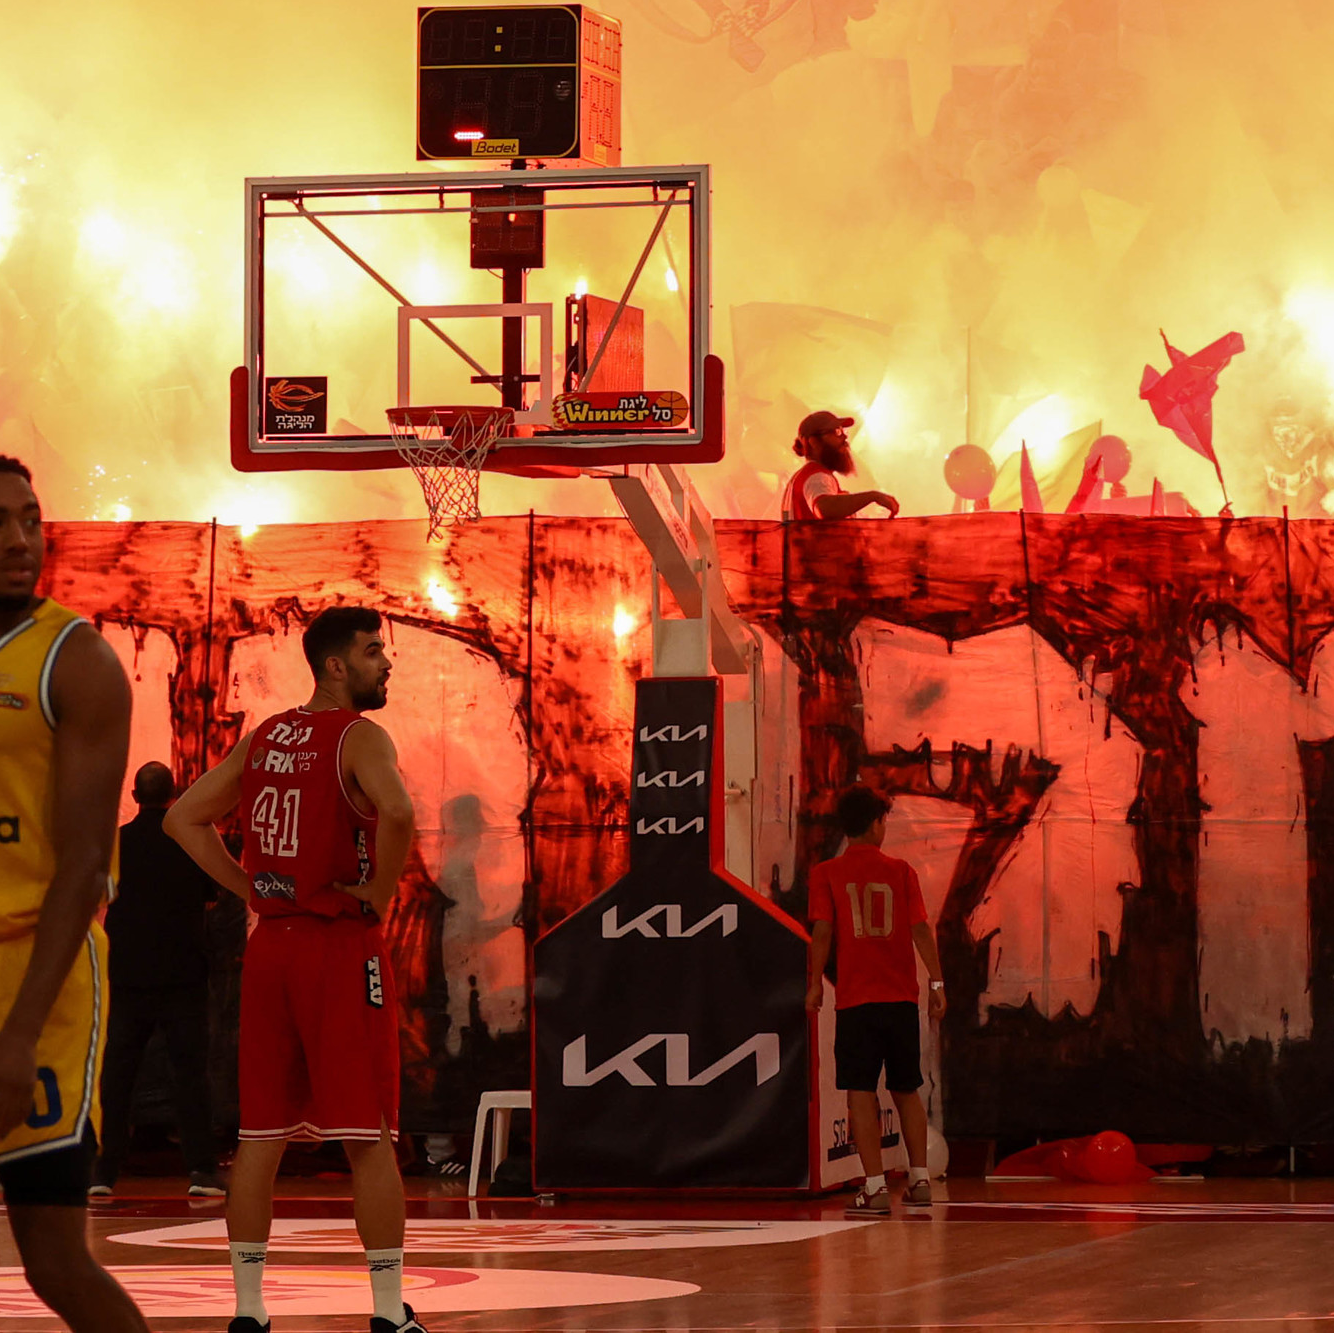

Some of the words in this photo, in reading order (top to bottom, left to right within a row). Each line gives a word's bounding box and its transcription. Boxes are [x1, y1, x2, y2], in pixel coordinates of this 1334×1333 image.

[475, 141, 517, 154] Bodet
[618, 395, 649, 410] ליגת
[275, 414, 315, 423] מנהלת
[652, 407, 672, 421] סל
[277, 421, 313, 430] הליגה
[251, 786, 301, 857] 41
[847, 882, 894, 939] 10
[368, 956, 384, 1006] TLV
[25, 1067, 63, 1129] 0
